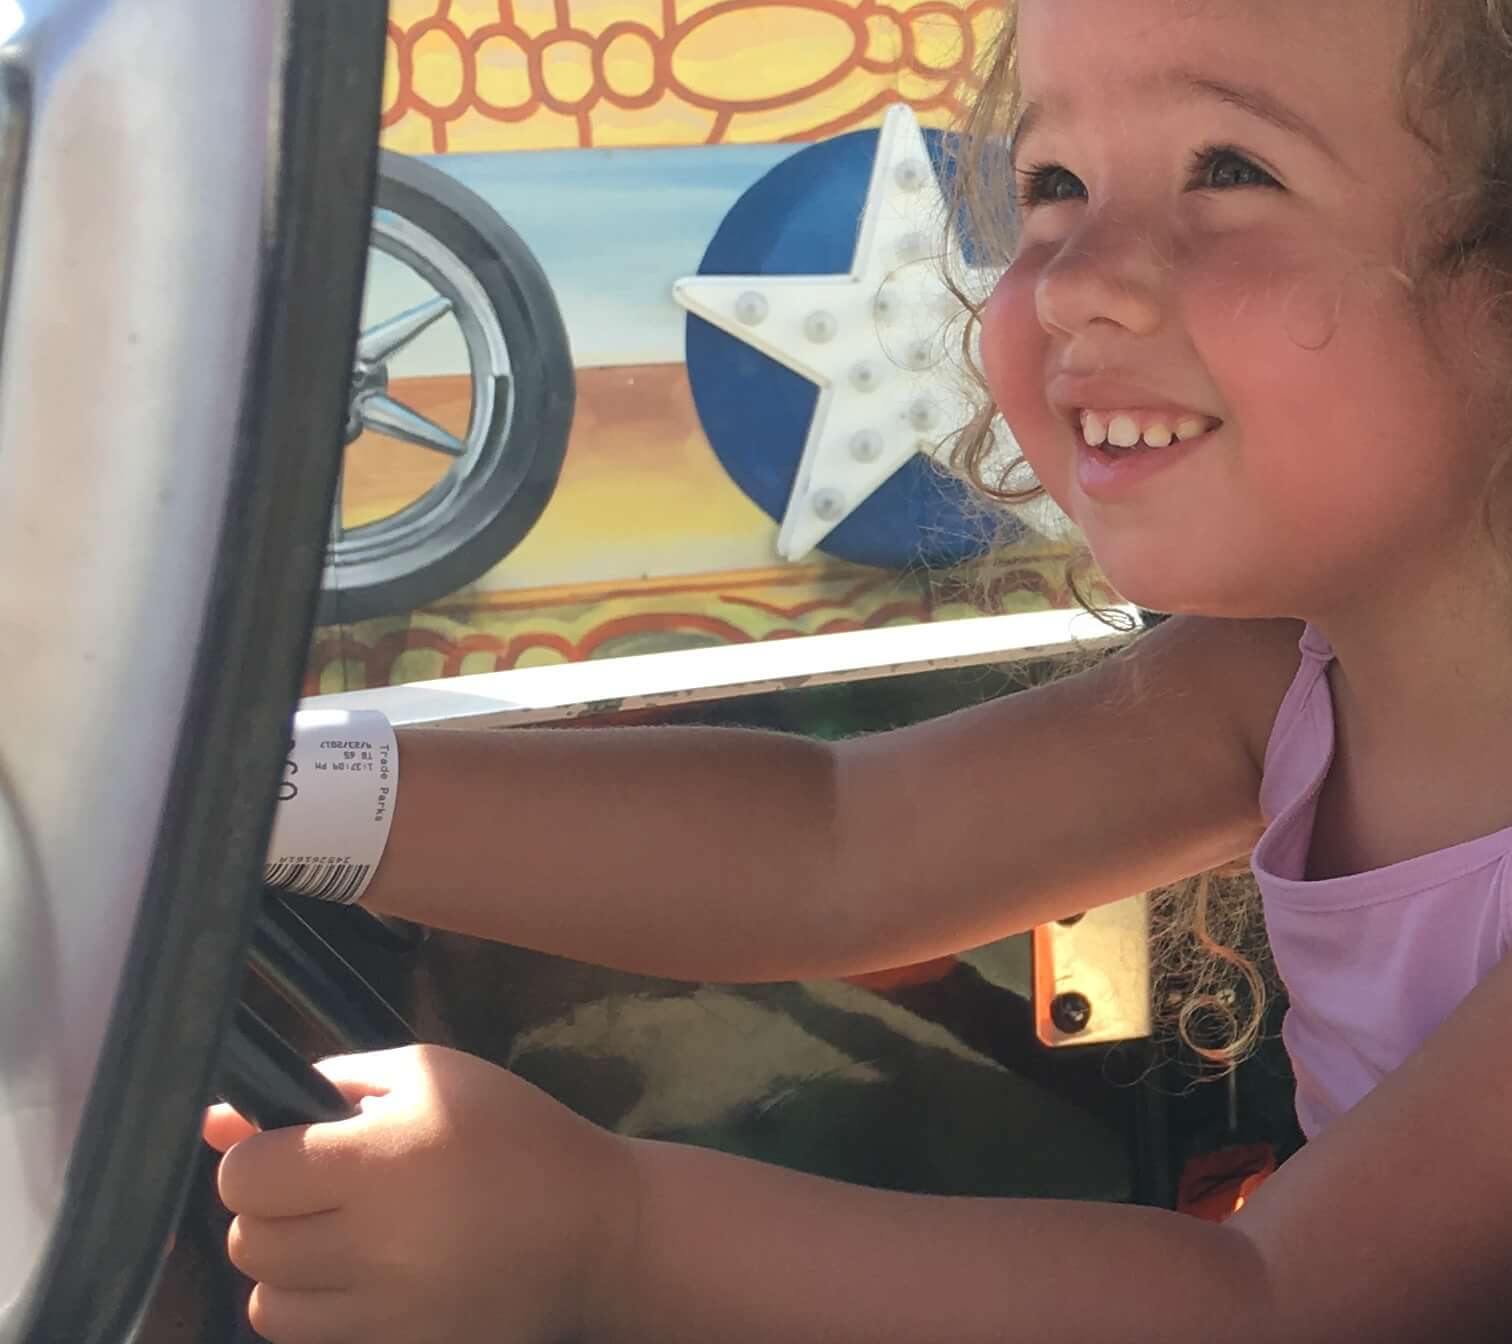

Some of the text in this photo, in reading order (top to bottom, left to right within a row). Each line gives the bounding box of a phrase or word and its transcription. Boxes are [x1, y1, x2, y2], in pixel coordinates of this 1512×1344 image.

[314, 761, 328, 770] PM
[374, 745, 390, 822] Trade Parks
